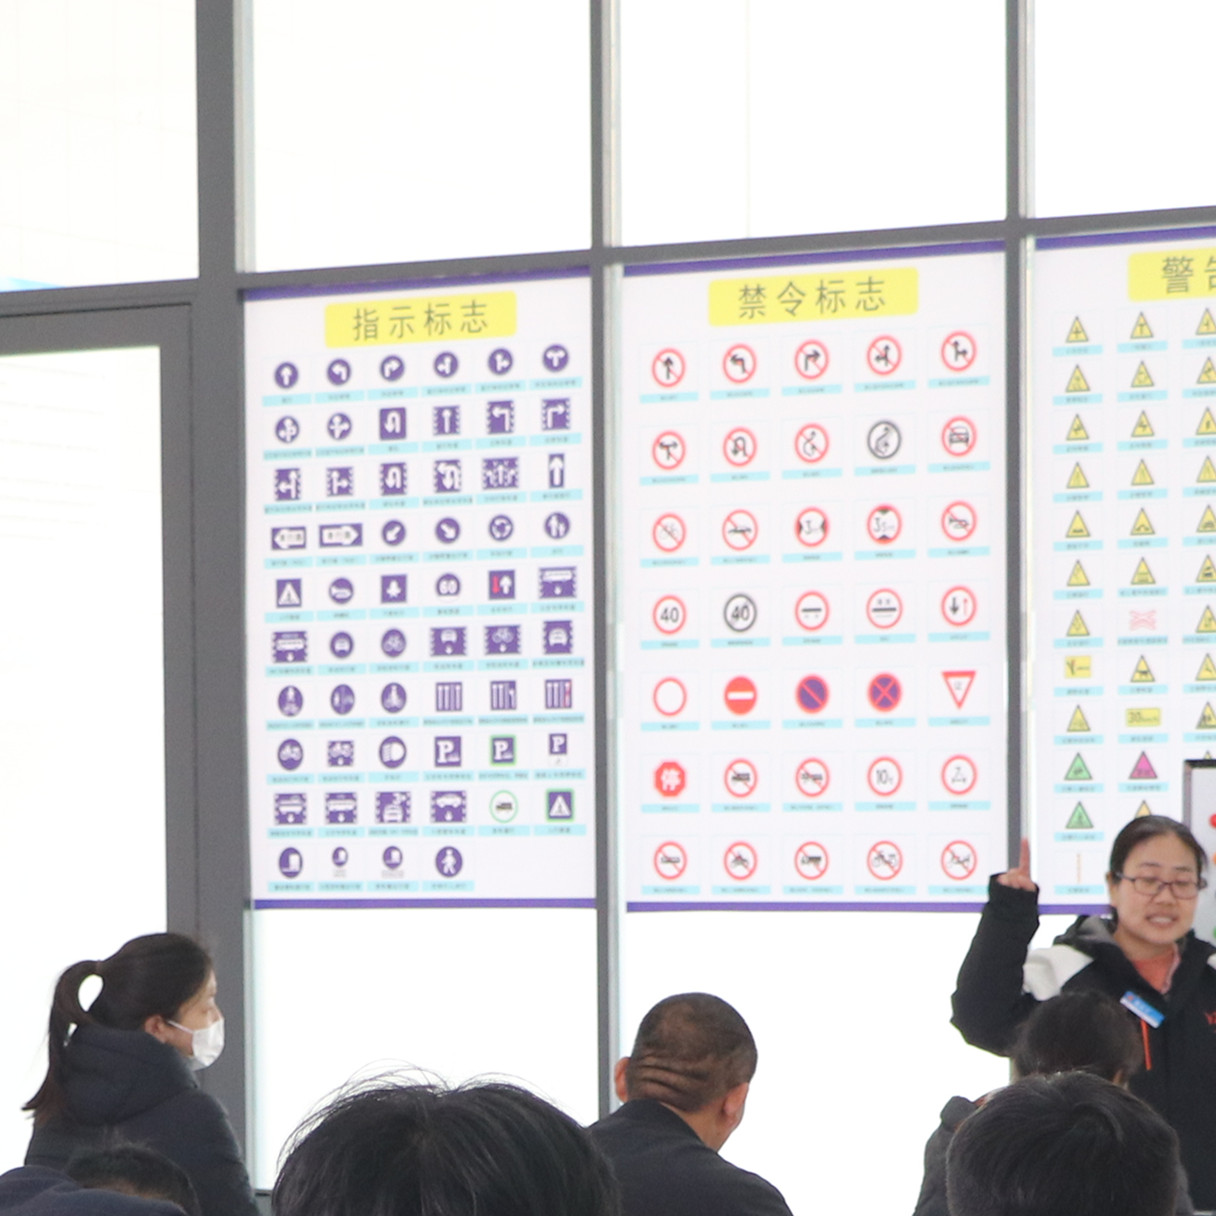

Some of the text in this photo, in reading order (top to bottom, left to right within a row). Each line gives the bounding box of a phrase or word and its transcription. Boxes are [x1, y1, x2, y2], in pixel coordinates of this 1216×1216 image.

[738, 275, 886, 320] 禁令标志
[353, 298, 489, 342] 指示标志
[660, 606, 680, 623] 40
[660, 768, 681, 792] 停
